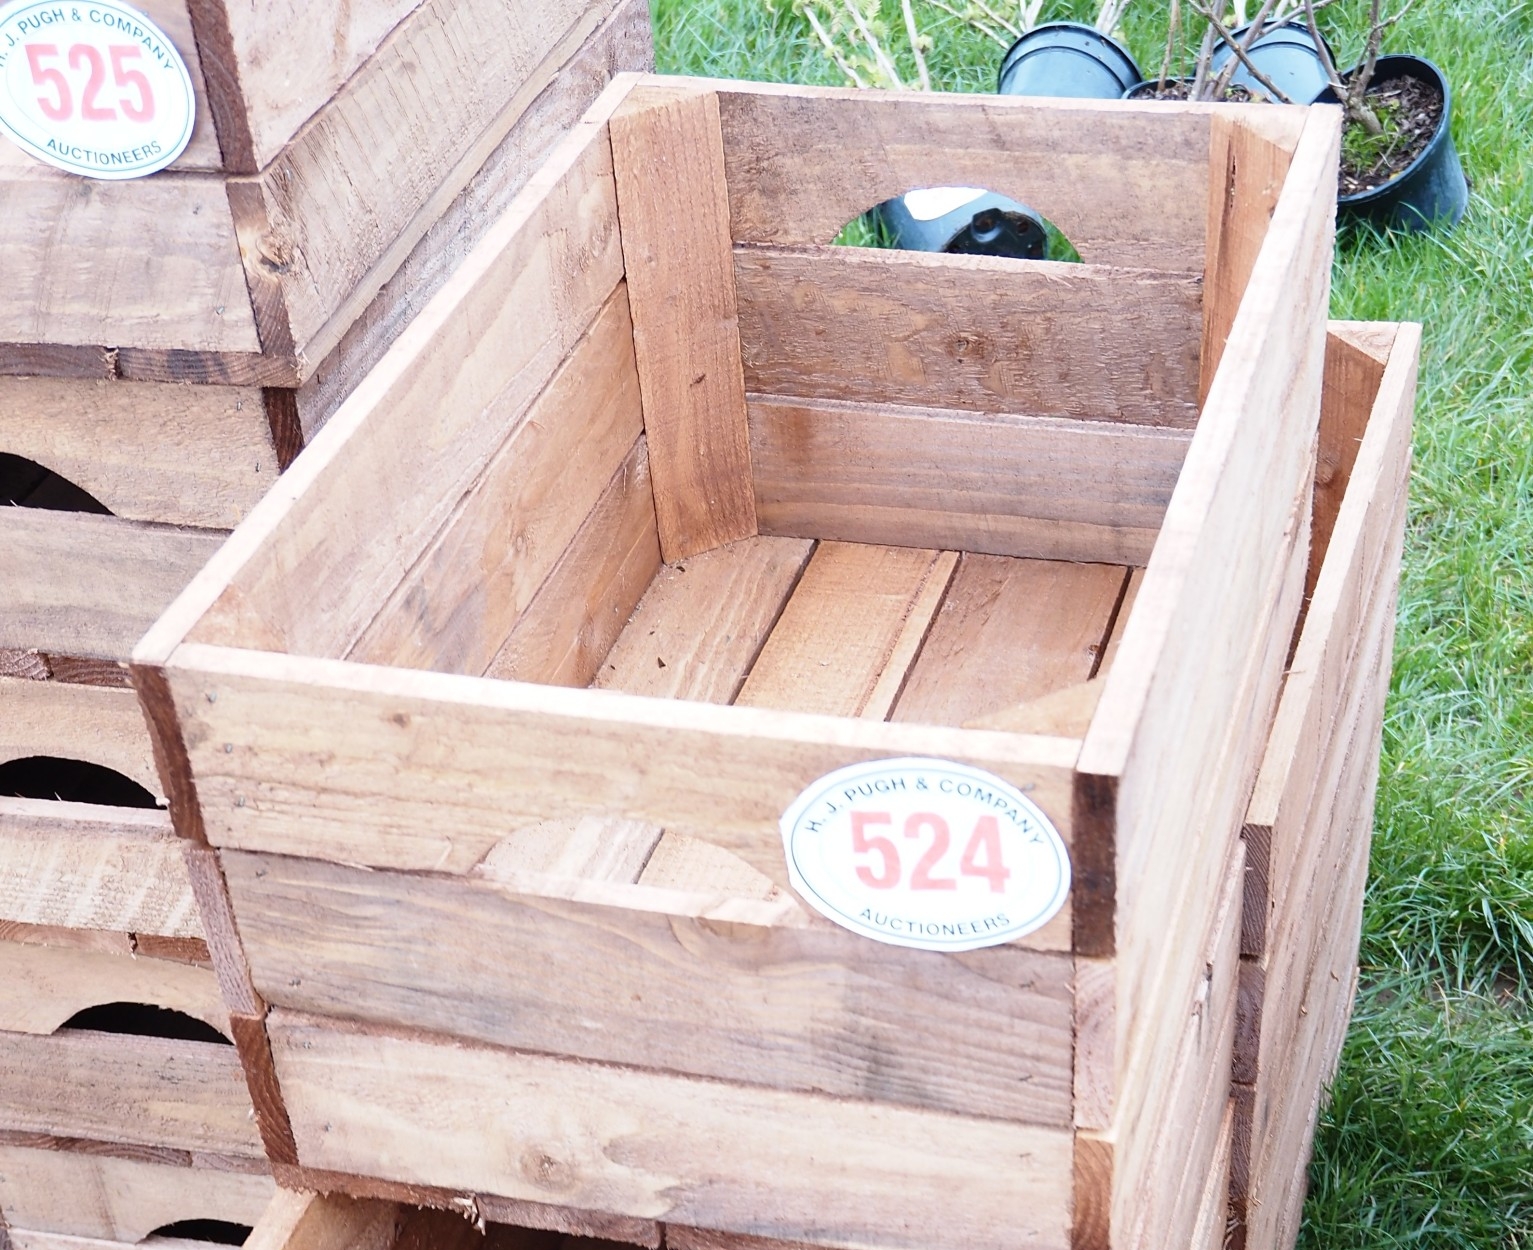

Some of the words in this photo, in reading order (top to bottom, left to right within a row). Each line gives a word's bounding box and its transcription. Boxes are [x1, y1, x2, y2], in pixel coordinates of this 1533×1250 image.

[17, 9, 65, 34] PUGH
[71, 7, 82, 22] &
[89, 9, 174, 71] COMPANY
[24, 43, 156, 123] 525
[46, 138, 162, 165] AUCTIONEERS
[804, 818, 826, 833] H.
[825, 801, 843, 814] J.
[844, 777, 906, 801] PUGH
[915, 776, 929, 791] &
[939, 779, 1045, 845] COMPANY
[850, 810, 1011, 894] 524
[859, 907, 1010, 936] AUCTIONEERS
